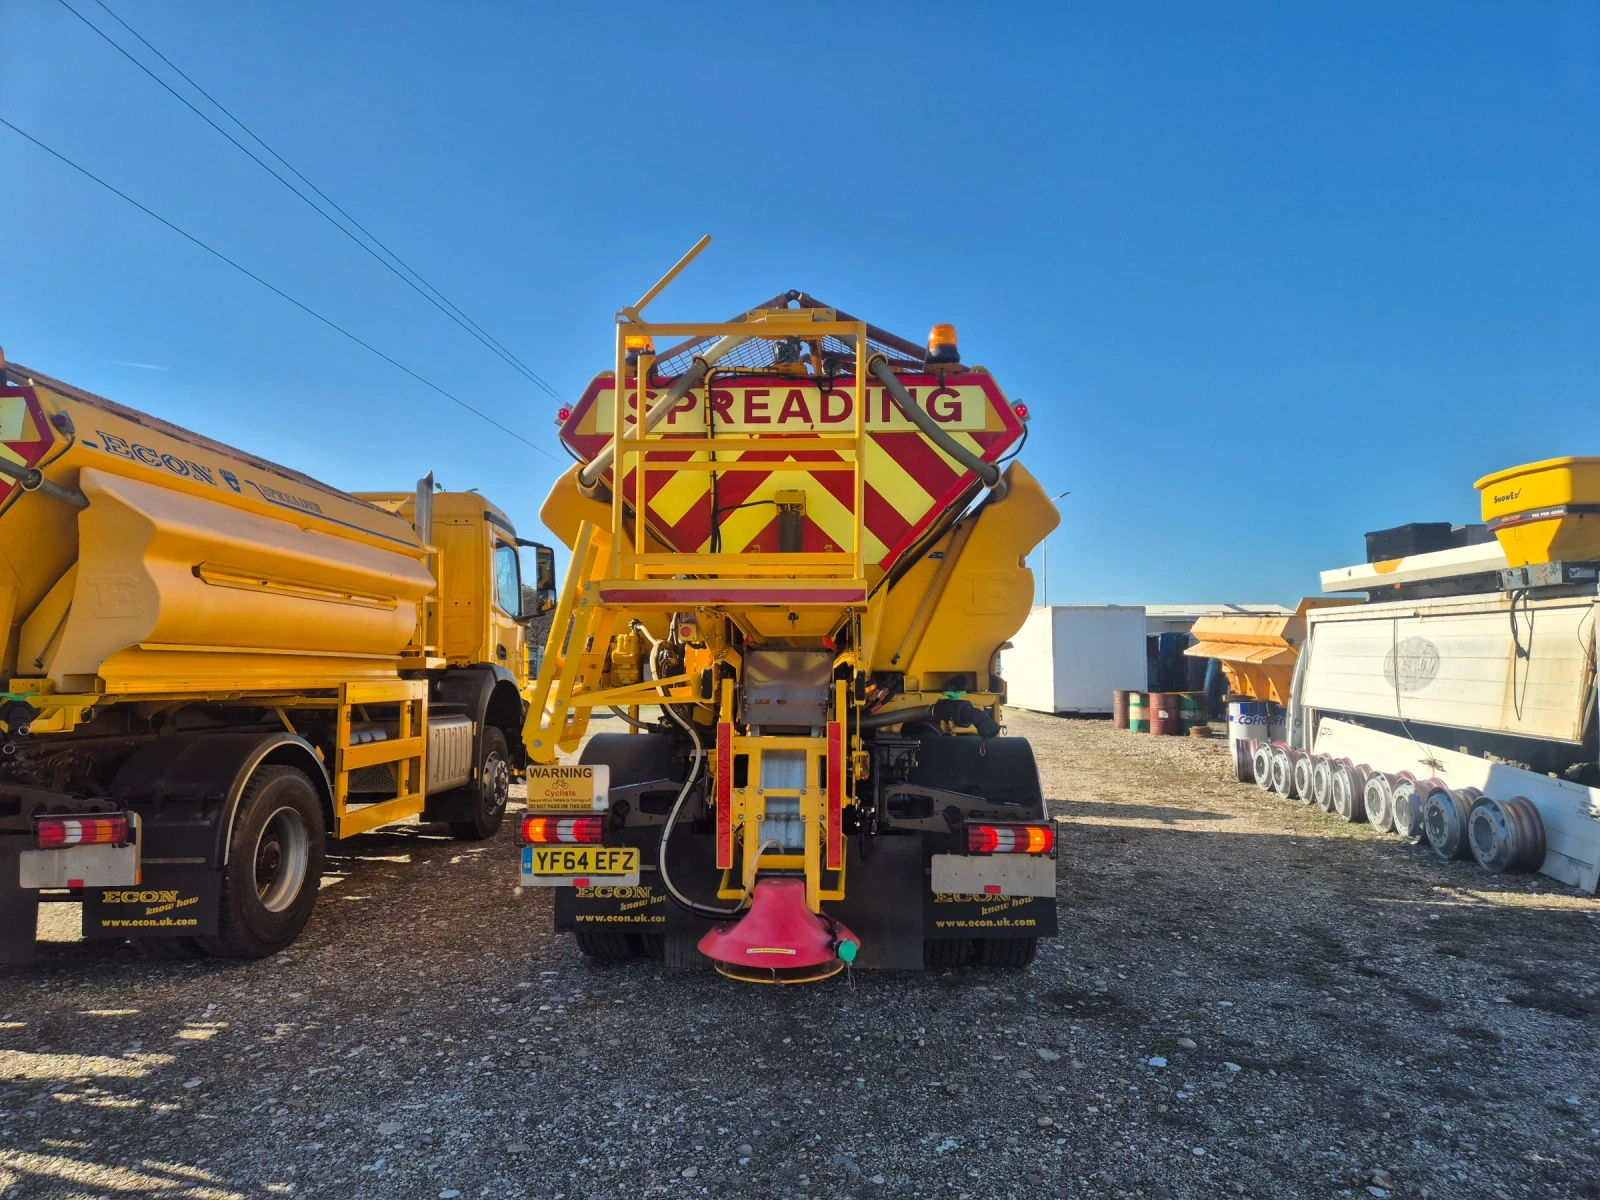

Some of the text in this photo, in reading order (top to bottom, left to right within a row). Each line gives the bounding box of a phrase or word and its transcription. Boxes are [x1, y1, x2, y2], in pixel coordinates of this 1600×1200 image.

[625, 388, 962, 424] SPREADING
[95, 429, 217, 486] ECON
[529, 768, 593, 778] WARNING
[544, 789, 577, 797] Cyclists
[536, 851, 634, 871] YF64 EFZ
[102, 890, 179, 903] ECON
[575, 886, 652, 898] ECON
[146, 896, 199, 915] know how
[620, 899, 648, 911] know
[981, 896, 1034, 916] know how
[102, 917, 198, 926] www.econ.uk.com
[936, 917, 1036, 928] www.econ.uk.com
